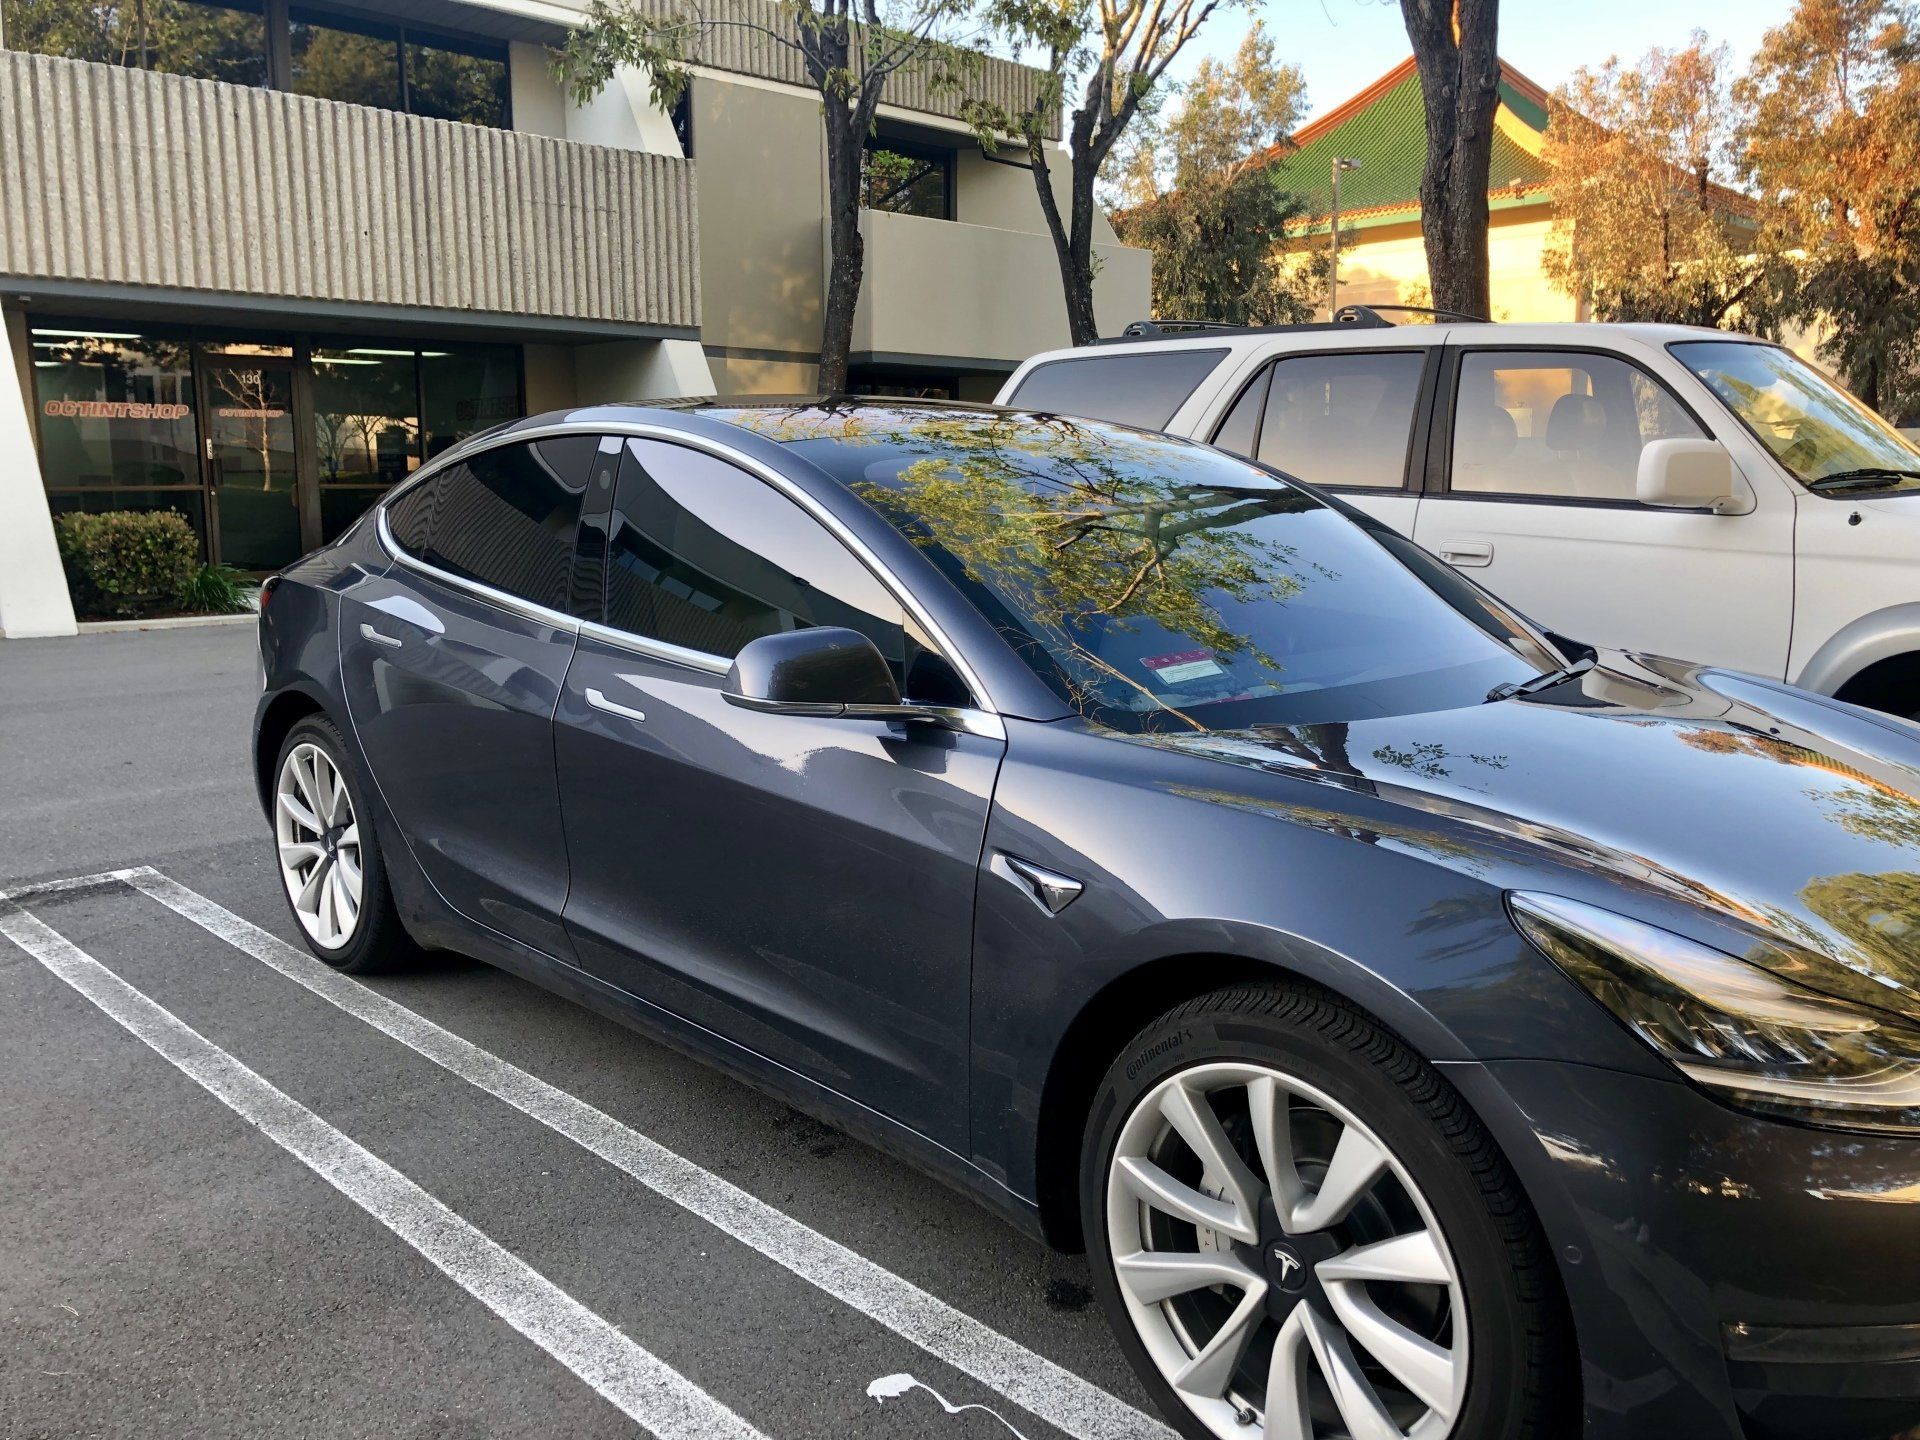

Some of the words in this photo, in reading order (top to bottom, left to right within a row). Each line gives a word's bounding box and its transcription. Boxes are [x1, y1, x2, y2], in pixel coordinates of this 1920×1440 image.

[241, 374, 260, 384] 130
[45, 400, 189, 420] OCTINTSHOP
[1126, 1031, 1184, 1080] Continental
